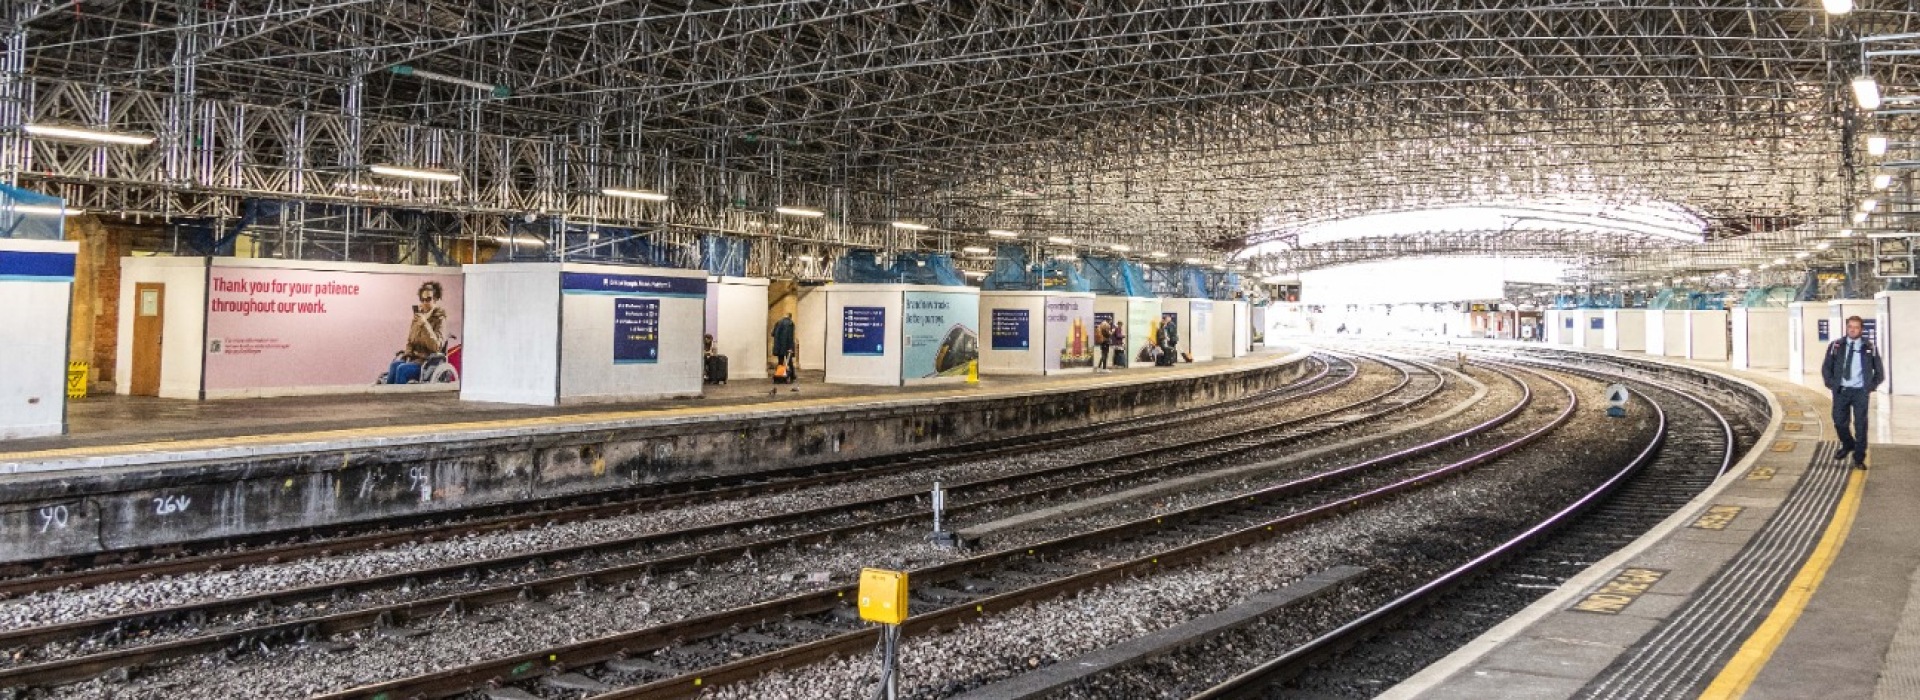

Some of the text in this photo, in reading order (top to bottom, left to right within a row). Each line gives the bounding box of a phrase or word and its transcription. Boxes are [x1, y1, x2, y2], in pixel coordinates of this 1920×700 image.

[213, 277, 360, 297] Thank you for your patience
[211, 298, 327, 316] throughout our work.
